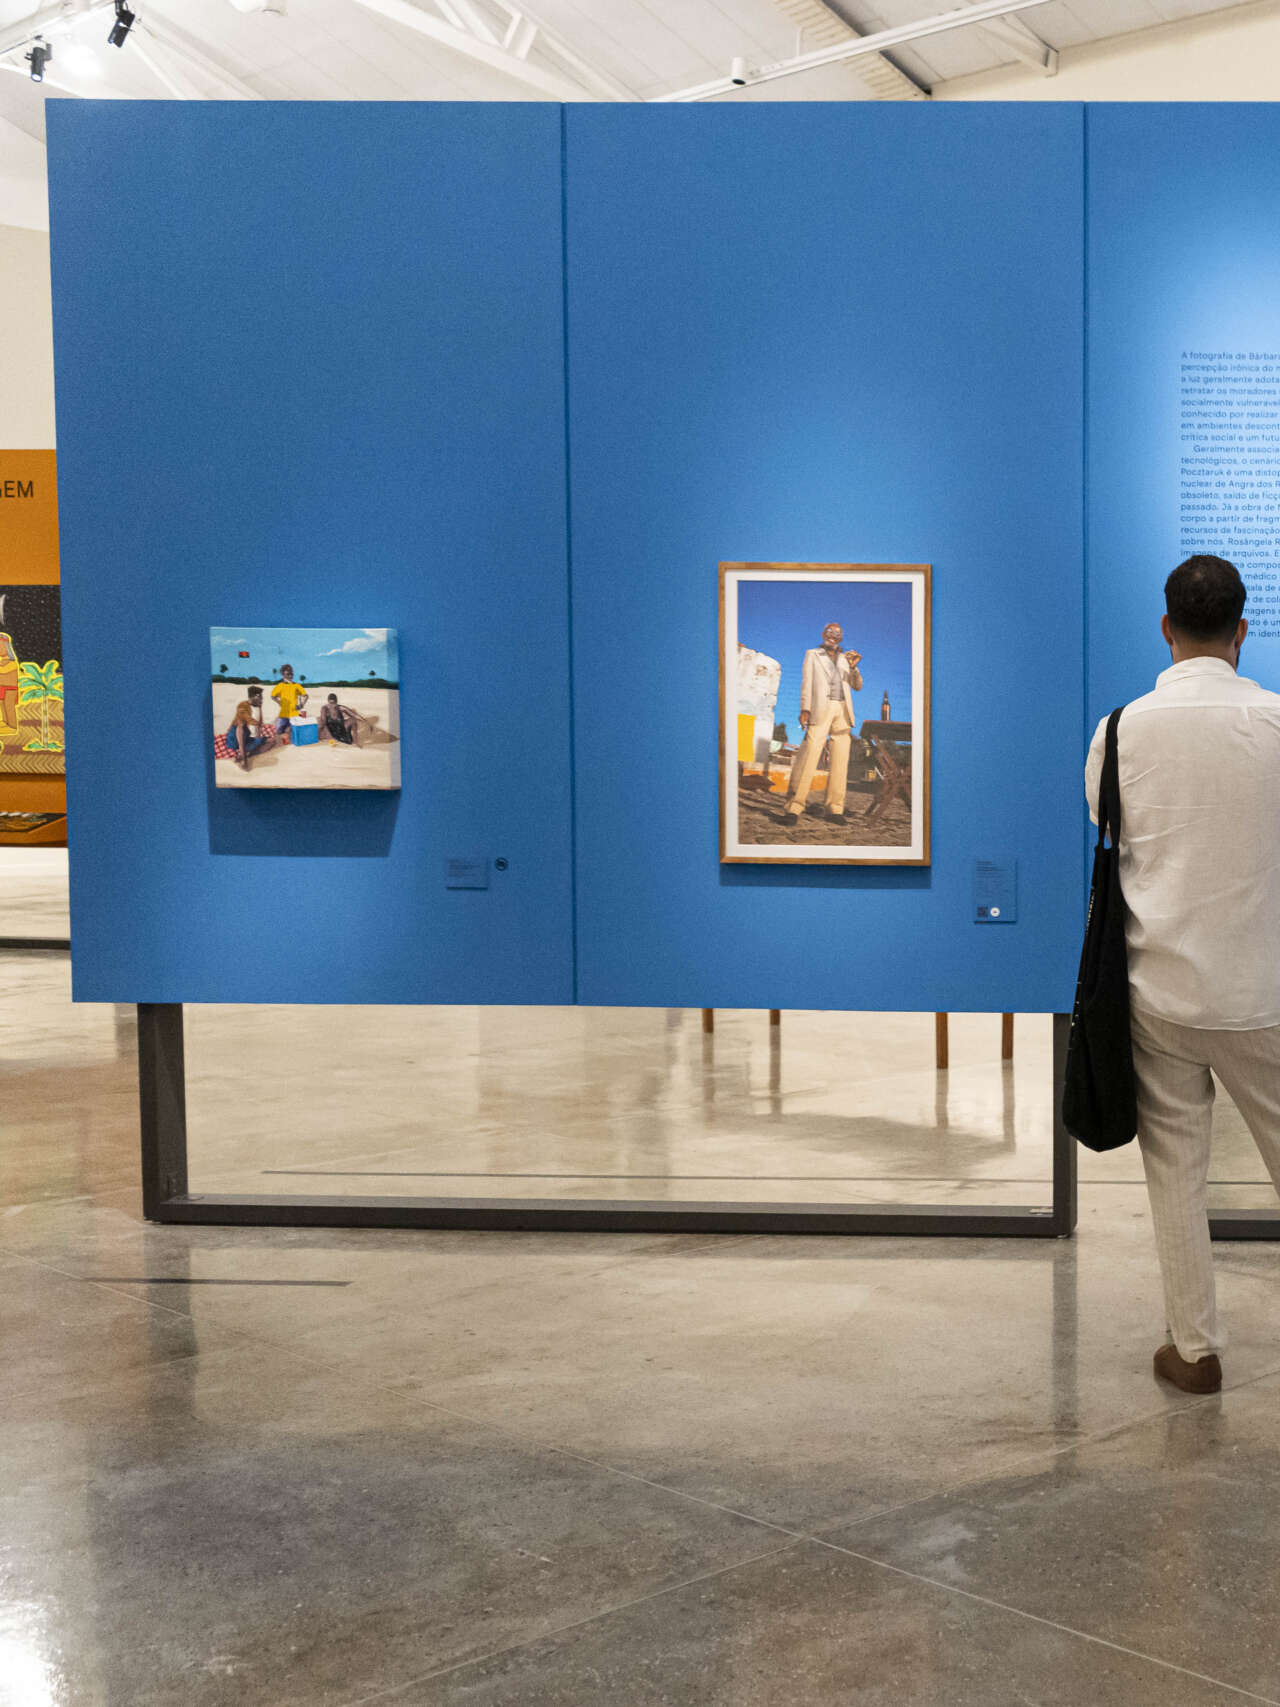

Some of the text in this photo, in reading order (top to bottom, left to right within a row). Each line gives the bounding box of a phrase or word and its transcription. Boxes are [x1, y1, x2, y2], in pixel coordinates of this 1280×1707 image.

[1181, 351, 1187, 360] A
[1189, 351, 1232, 361] fotografia
[1235, 351, 1246, 360] de
[1262, 363, 1273, 372] do
[1188, 374, 1200, 383] luz
[1202, 374, 1252, 384] geralmente
[1180, 386, 1213, 394] retratar
[1229, 386, 1276, 395] moradores
[1180, 398, 1233, 406] socialmente
[1180, 409, 1226, 418] conhecido
[1229, 411, 1243, 420] por
[1246, 409, 1277, 418] realizar
[1197, 421, 1242, 430] ambientes
[1210, 432, 1235, 441] social
[1193, 444, 1244, 453] Geralmente
[1180, 479, 1211, 487] nuclear
[1215, 479, 1225, 488] de
[1228, 479, 1254, 489] Angra
[1256, 479, 1272, 488] dos
[0, 480, 34, 498] EM
[1248, 490, 1259, 499] de
[1241, 502, 1261, 511] obra
[1264, 502, 1274, 511] de
[1180, 515, 1206, 524] corpo
[1216, 514, 1239, 524] partir
[1242, 514, 1253, 522] de
[1220, 525, 1231, 534] de
[1233, 525, 1280, 535] fascinação
[1180, 536, 1204, 545] sobre
[1264, 583, 1275, 592] de
